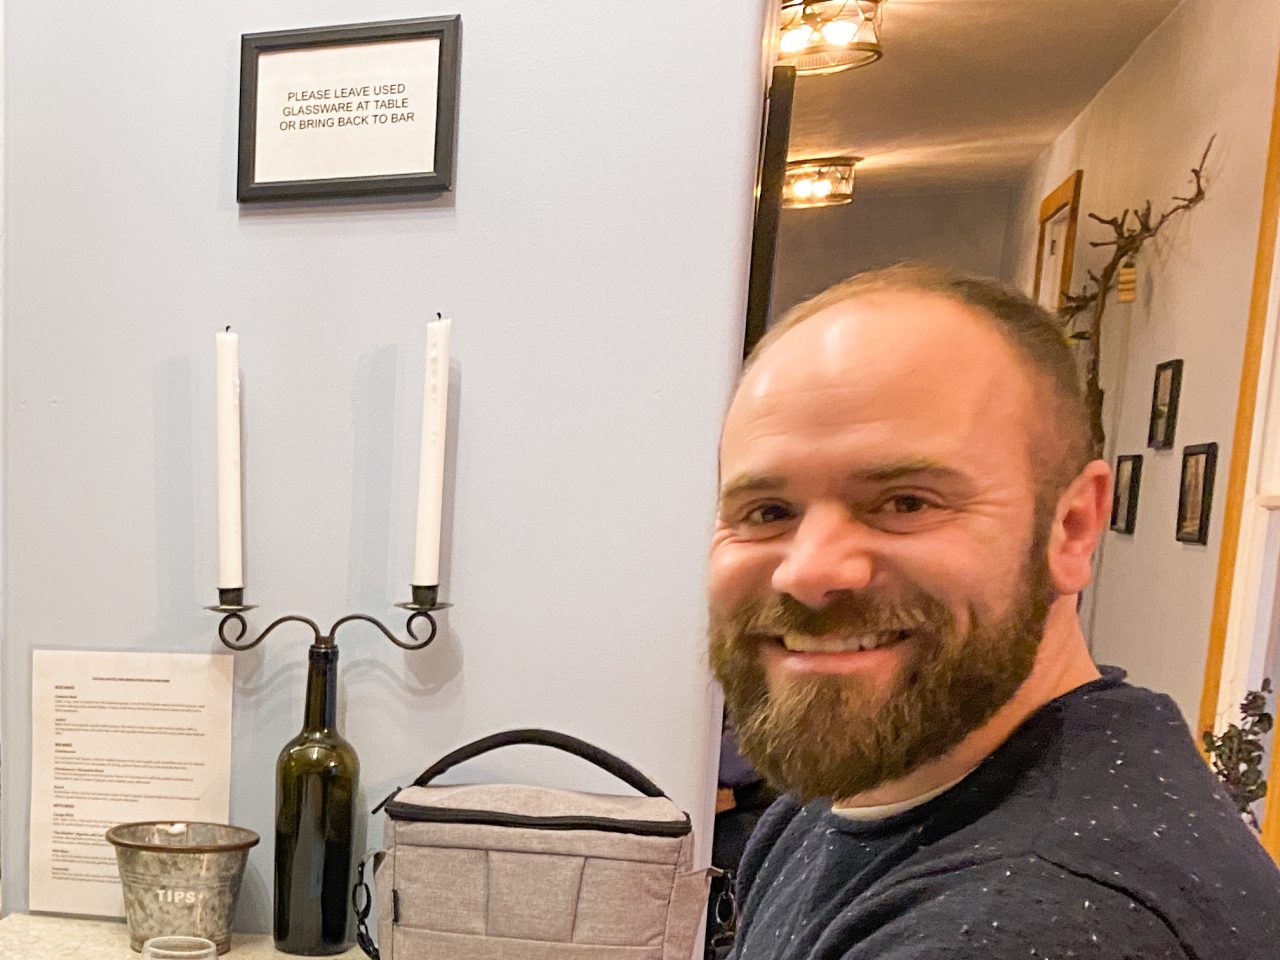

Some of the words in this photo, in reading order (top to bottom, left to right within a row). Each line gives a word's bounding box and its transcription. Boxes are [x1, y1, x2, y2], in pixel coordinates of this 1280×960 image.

[287, 89, 331, 102] PLEASE
[334, 86, 370, 98] LEAVE
[373, 83, 406, 95] USED
[282, 103, 353, 117] GLASSWARE
[356, 100, 370, 111] AT
[373, 97, 409, 110] TABLE
[279, 120, 296, 131] OR
[298, 117, 335, 130] BRING
[338, 114, 369, 126] BACK
[372, 113, 389, 124] TO
[391, 112, 415, 124] BAR
[156, 889, 196, 904] TIPS
